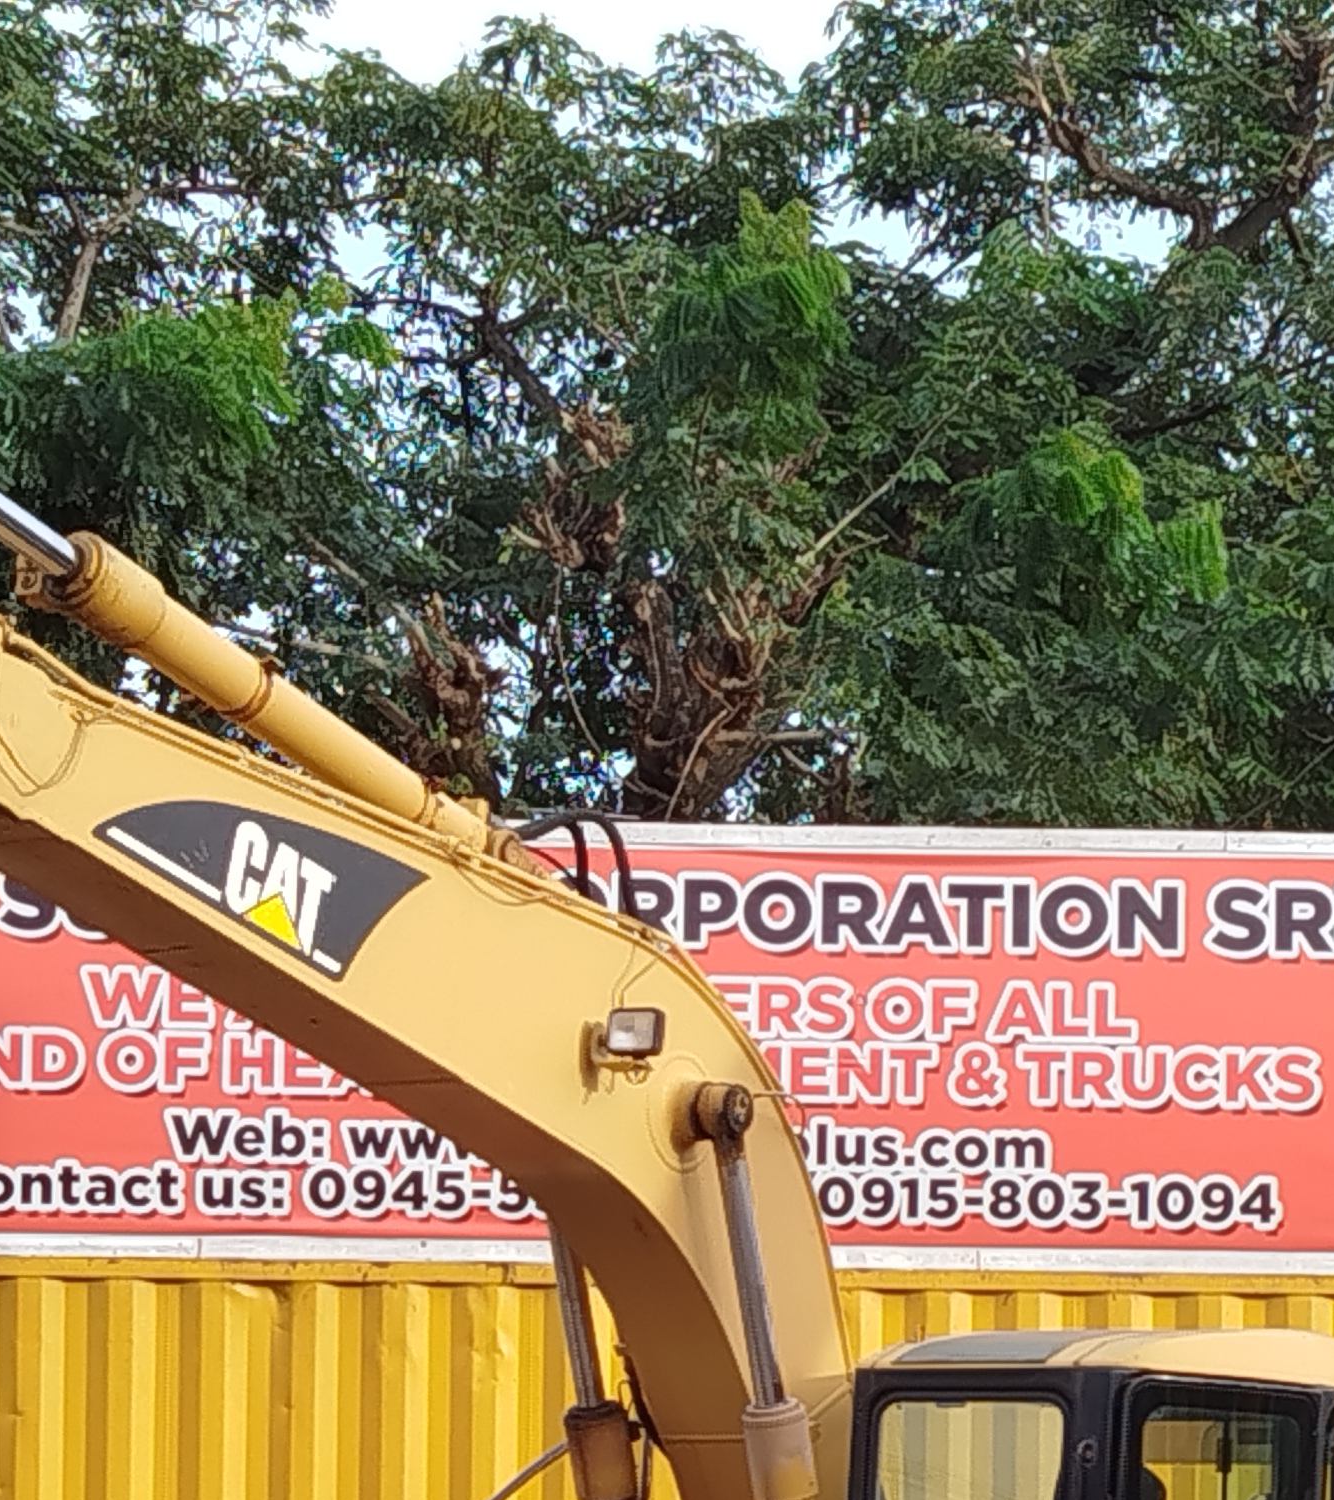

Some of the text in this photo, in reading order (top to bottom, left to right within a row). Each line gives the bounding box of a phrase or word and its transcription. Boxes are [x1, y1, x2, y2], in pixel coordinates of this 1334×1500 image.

[225, 821, 336, 956] CAT
[867, 978, 978, 1042] OF
[994, 980, 1138, 1044] ALL
[97, 1028, 212, 1094] OF
[222, 1030, 372, 1097] HE
[948, 1042, 1008, 1107] &
[1017, 1046, 1323, 1111] TRUCKS
[166, 1110, 330, 1163] Web:
[798, 1117, 1051, 1173] lus.com
[195, 1166, 292, 1217] us:
[304, 1164, 547, 1220] 0945-5
[816, 1172, 1283, 1231] 0915-803-1094
